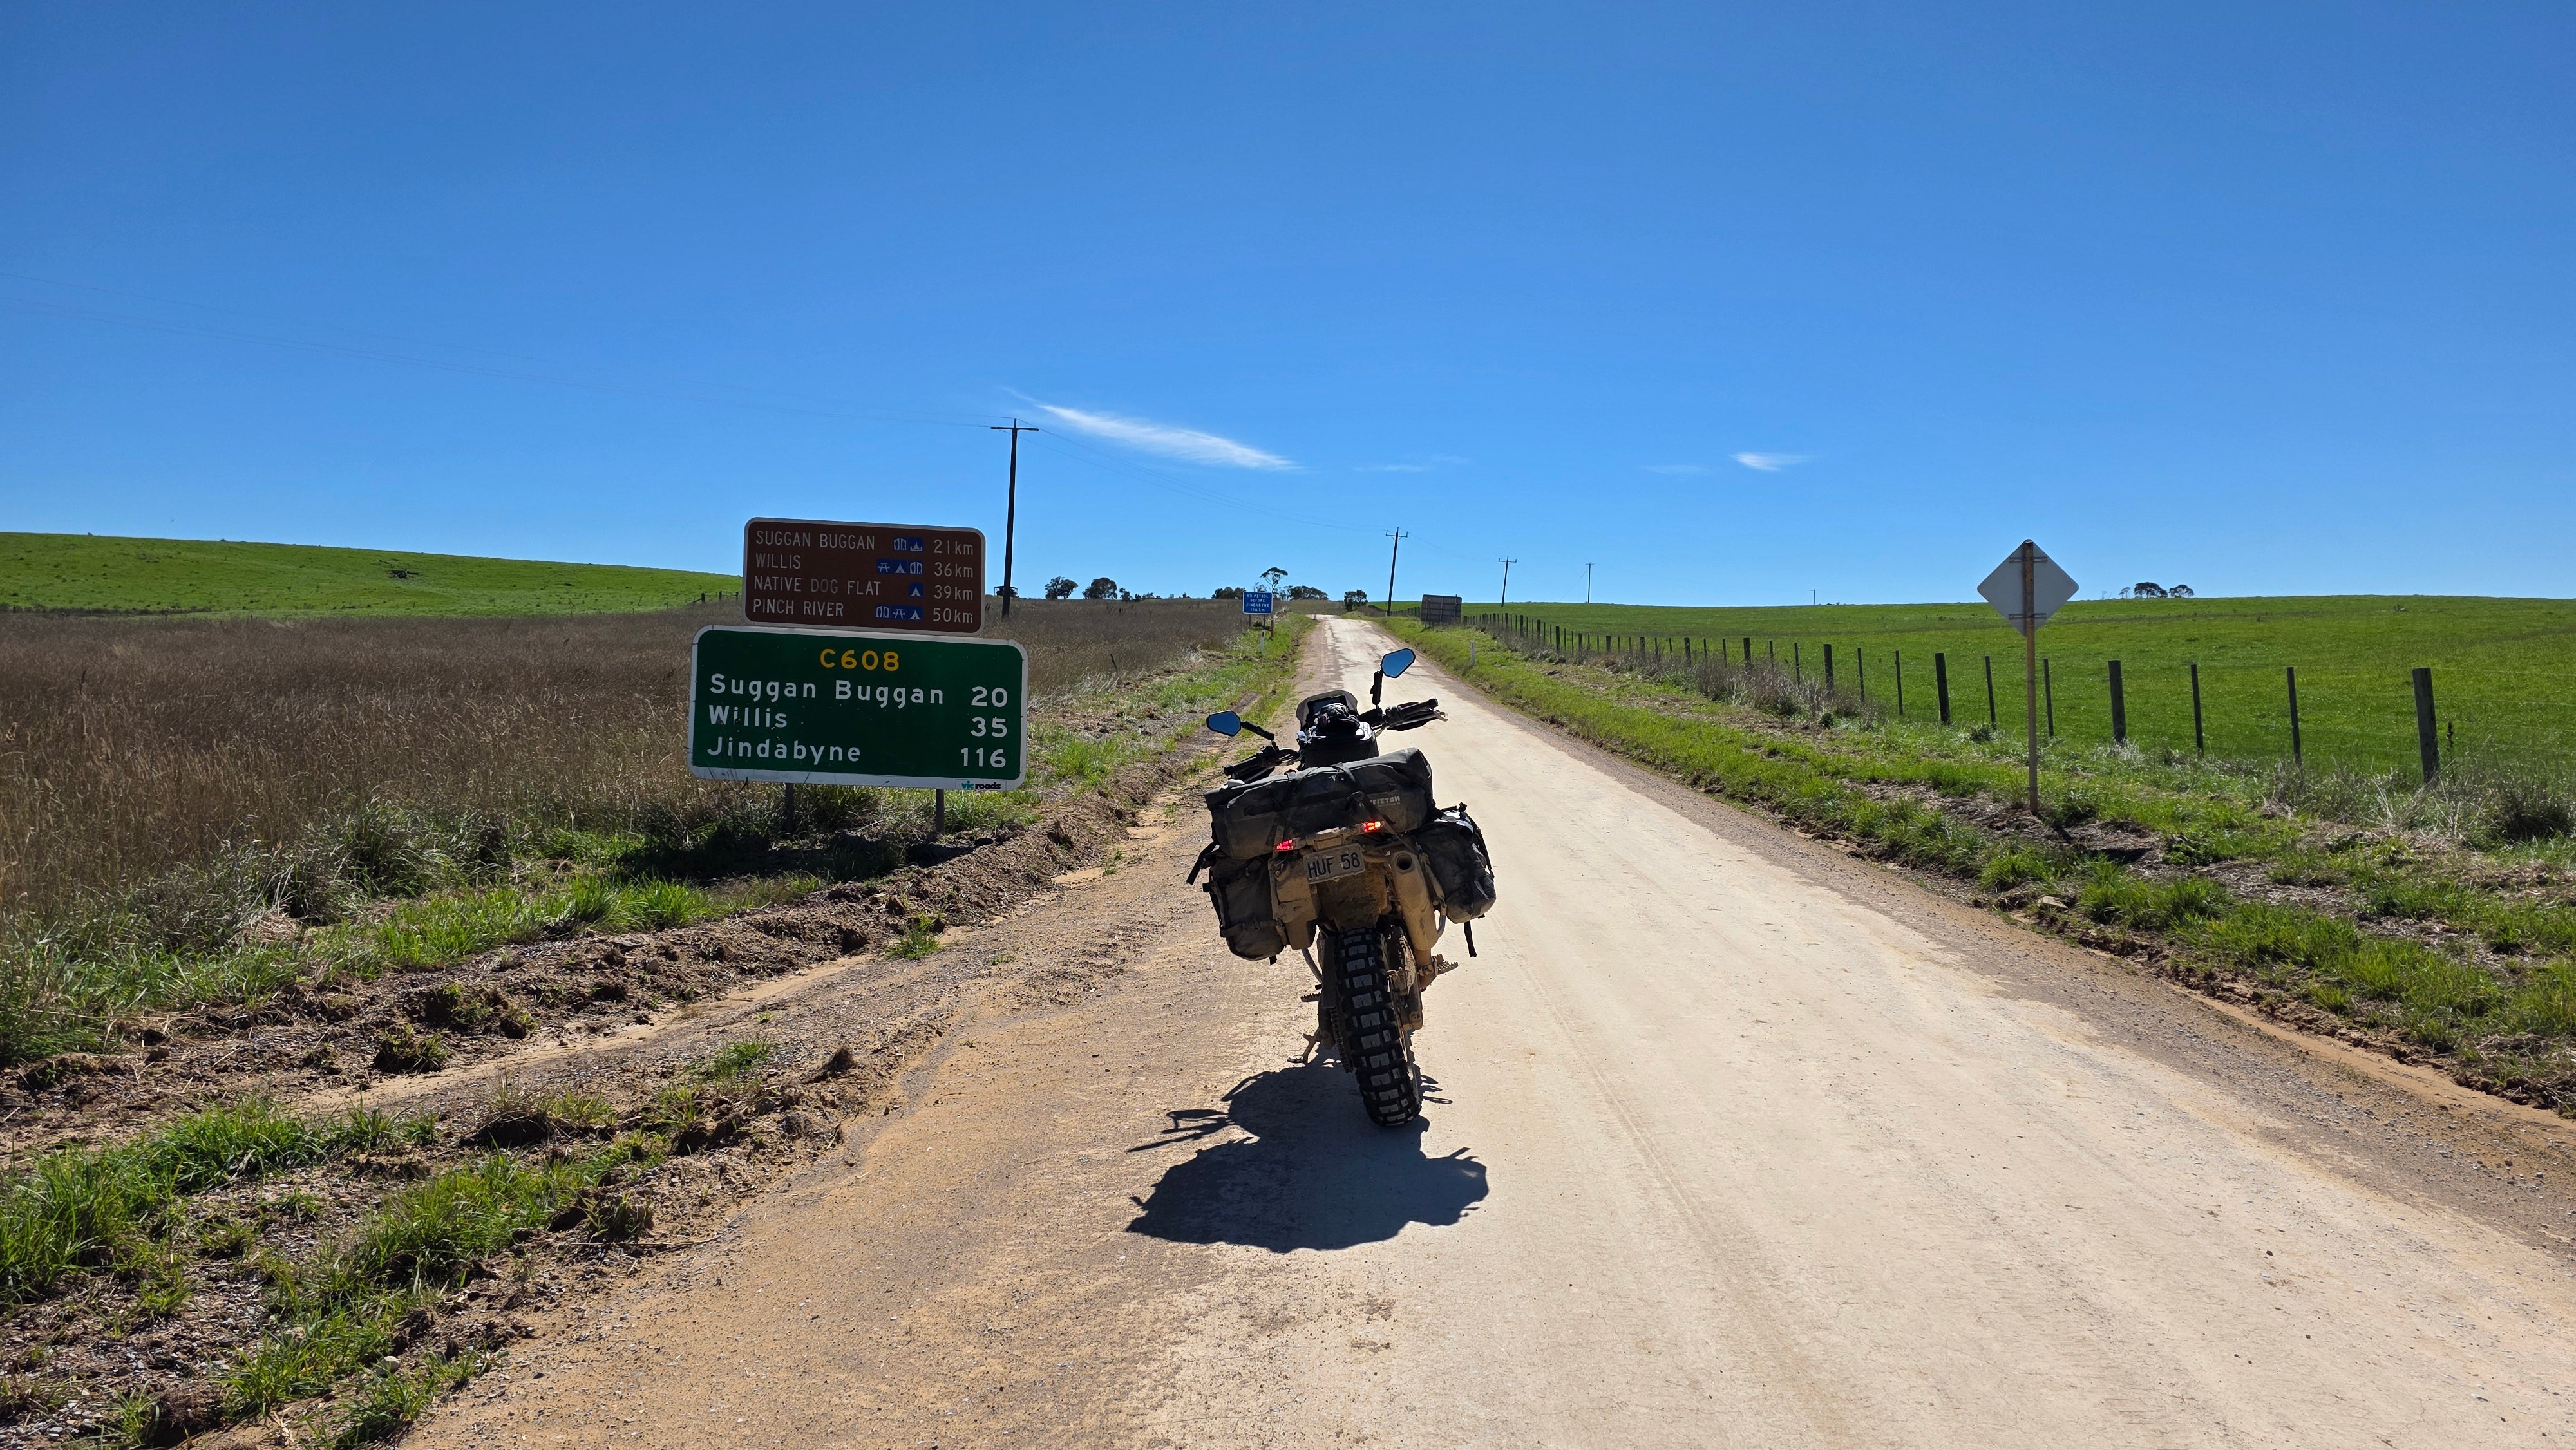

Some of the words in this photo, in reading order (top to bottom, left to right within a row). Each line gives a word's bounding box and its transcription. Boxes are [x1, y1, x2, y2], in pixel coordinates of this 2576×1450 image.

[755, 530, 811, 548] SUGGAN
[820, 533, 875, 551] BUGGAN
[755, 553, 802, 570] WILLIS
[753, 575, 802, 592] NATIVE
[811, 578, 838, 594] DOG
[848, 580, 882, 596] FLAT
[753, 598, 795, 615] PINCH
[803, 601, 844, 617] RIVER
[820, 648, 899, 672] C608
[710, 673, 817, 703] Suggan
[835, 679, 943, 709] Buggan
[971, 686, 1008, 708] 20
[708, 704, 787, 728] Willis
[971, 716, 1007, 738] 35
[706, 736, 861, 765] Jindabyne
[961, 747, 1006, 768] 116
[961, 780, 974, 789] vic
[975, 782, 1001, 790] roads
[1307, 856, 1335, 879] HUF
[1340, 852, 1361, 871] 58
